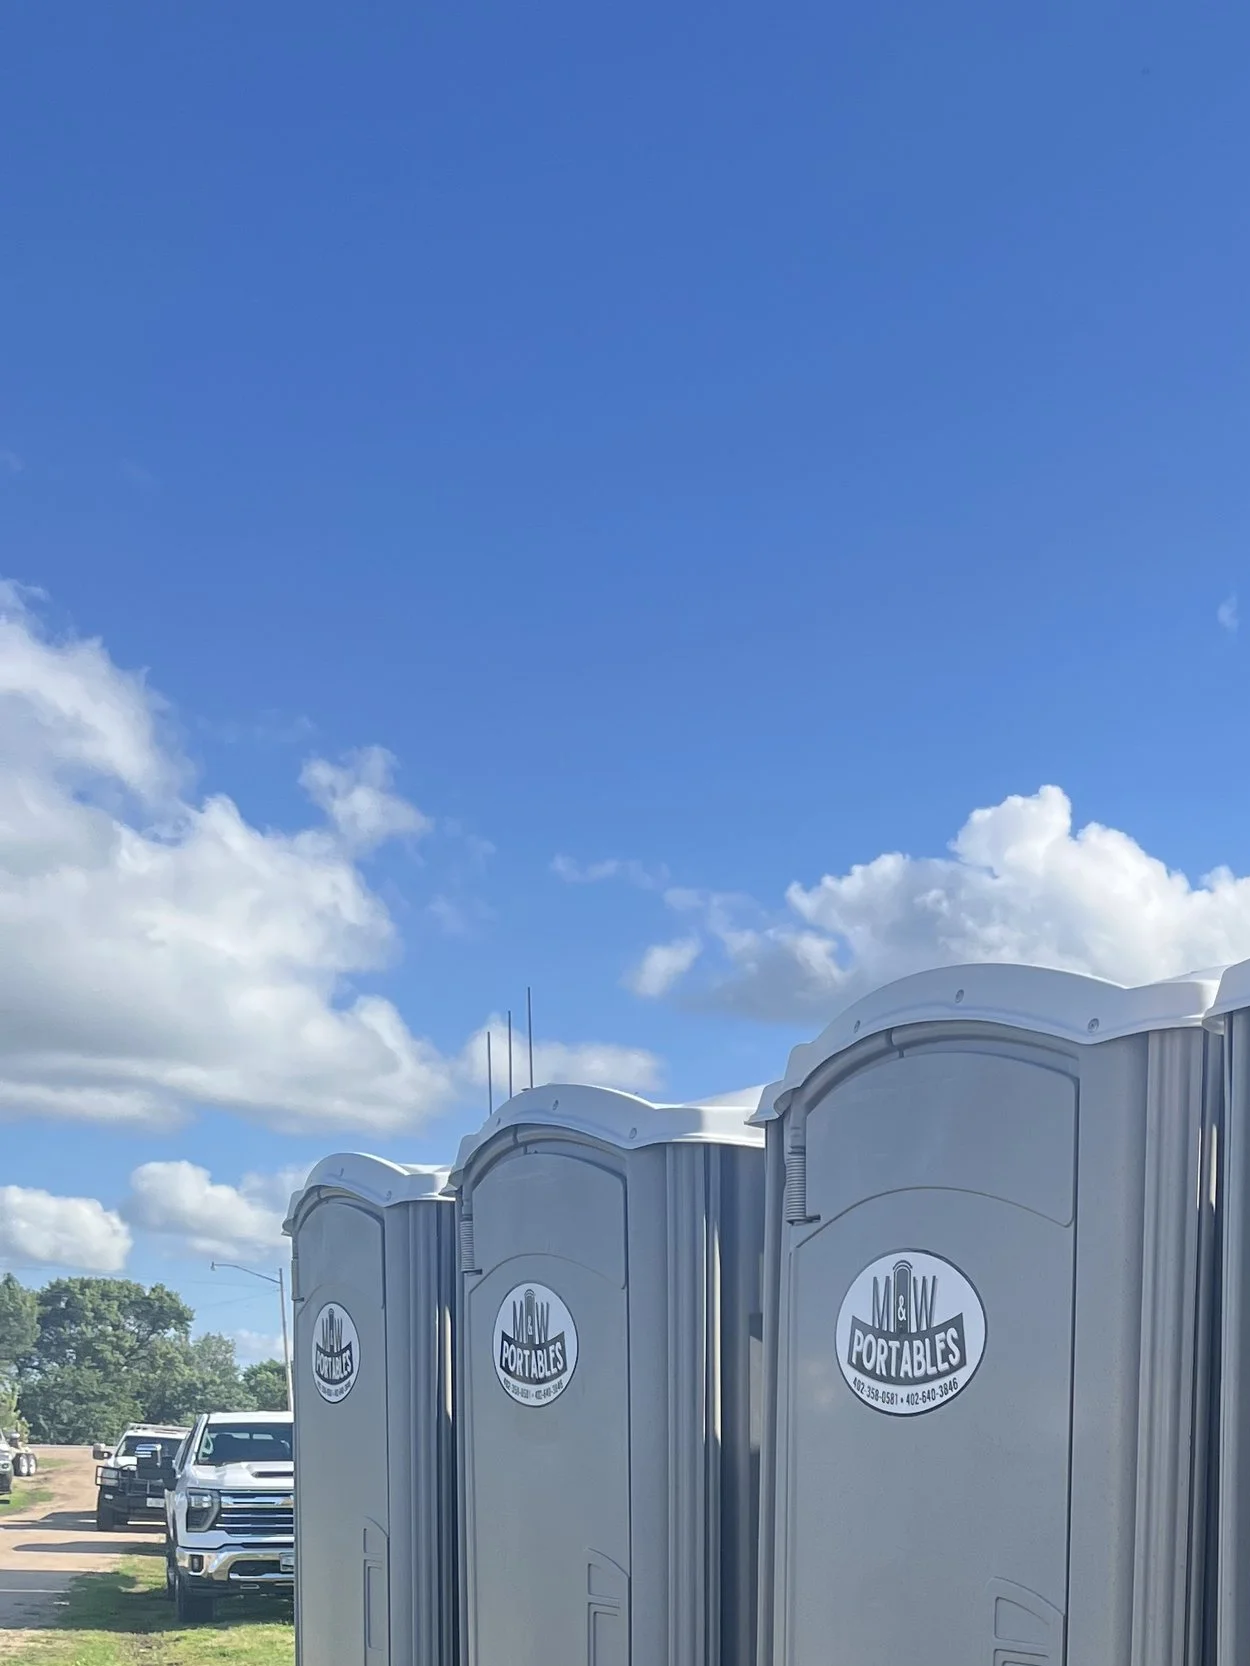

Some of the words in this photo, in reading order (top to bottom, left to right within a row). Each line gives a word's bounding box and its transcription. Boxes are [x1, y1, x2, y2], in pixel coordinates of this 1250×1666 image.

[502, 1340, 564, 1379] PORTABLES
[851, 1326, 960, 1379] PORTABLES
[852, 1376, 899, 1406] 402-358-0581
[905, 1377, 959, 1406] 402-640-3846
